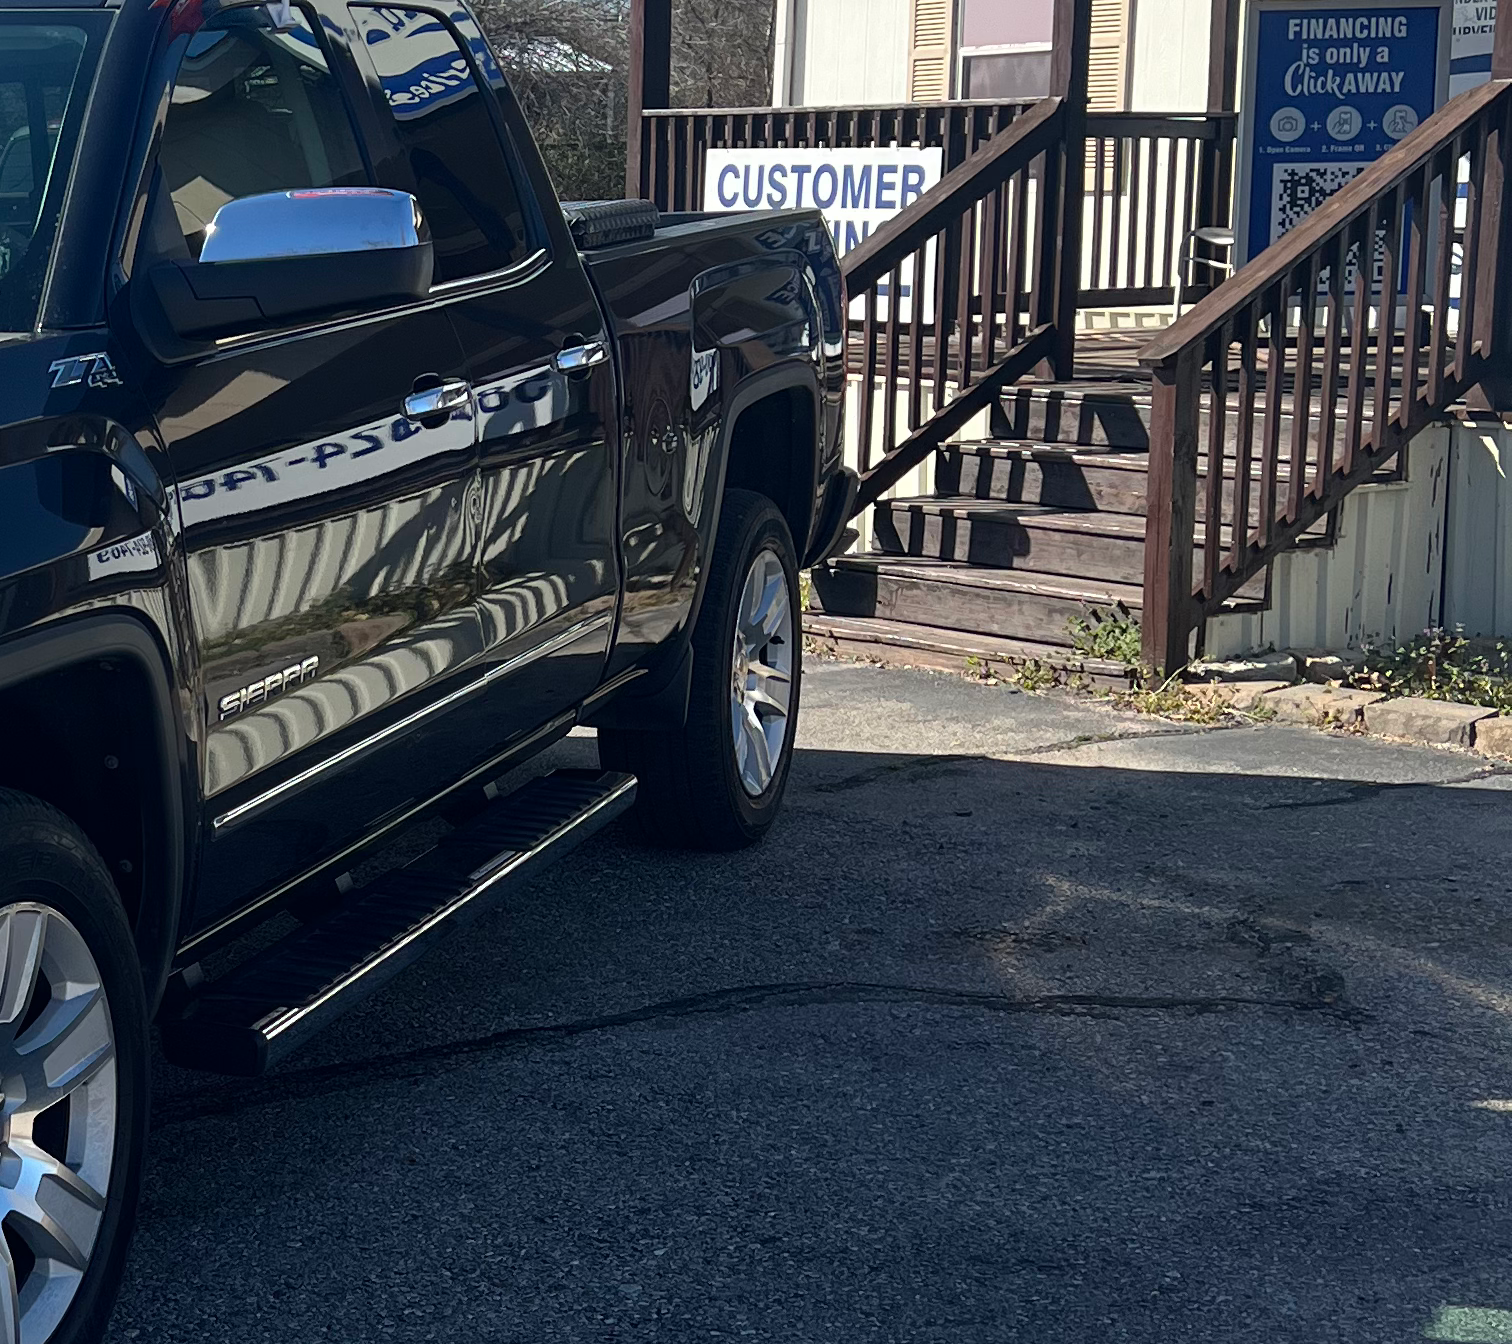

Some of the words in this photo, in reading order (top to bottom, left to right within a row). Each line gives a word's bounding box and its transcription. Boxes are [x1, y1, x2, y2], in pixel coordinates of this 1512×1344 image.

[1288, 16, 1407, 40] FINANCING
[1302, 43, 1320, 65] is
[1325, 42, 1371, 68] only
[1376, 46, 1390, 63] a
[717, 163, 926, 210] CUSTOMER
[218, 655, 320, 721] SIERRA
